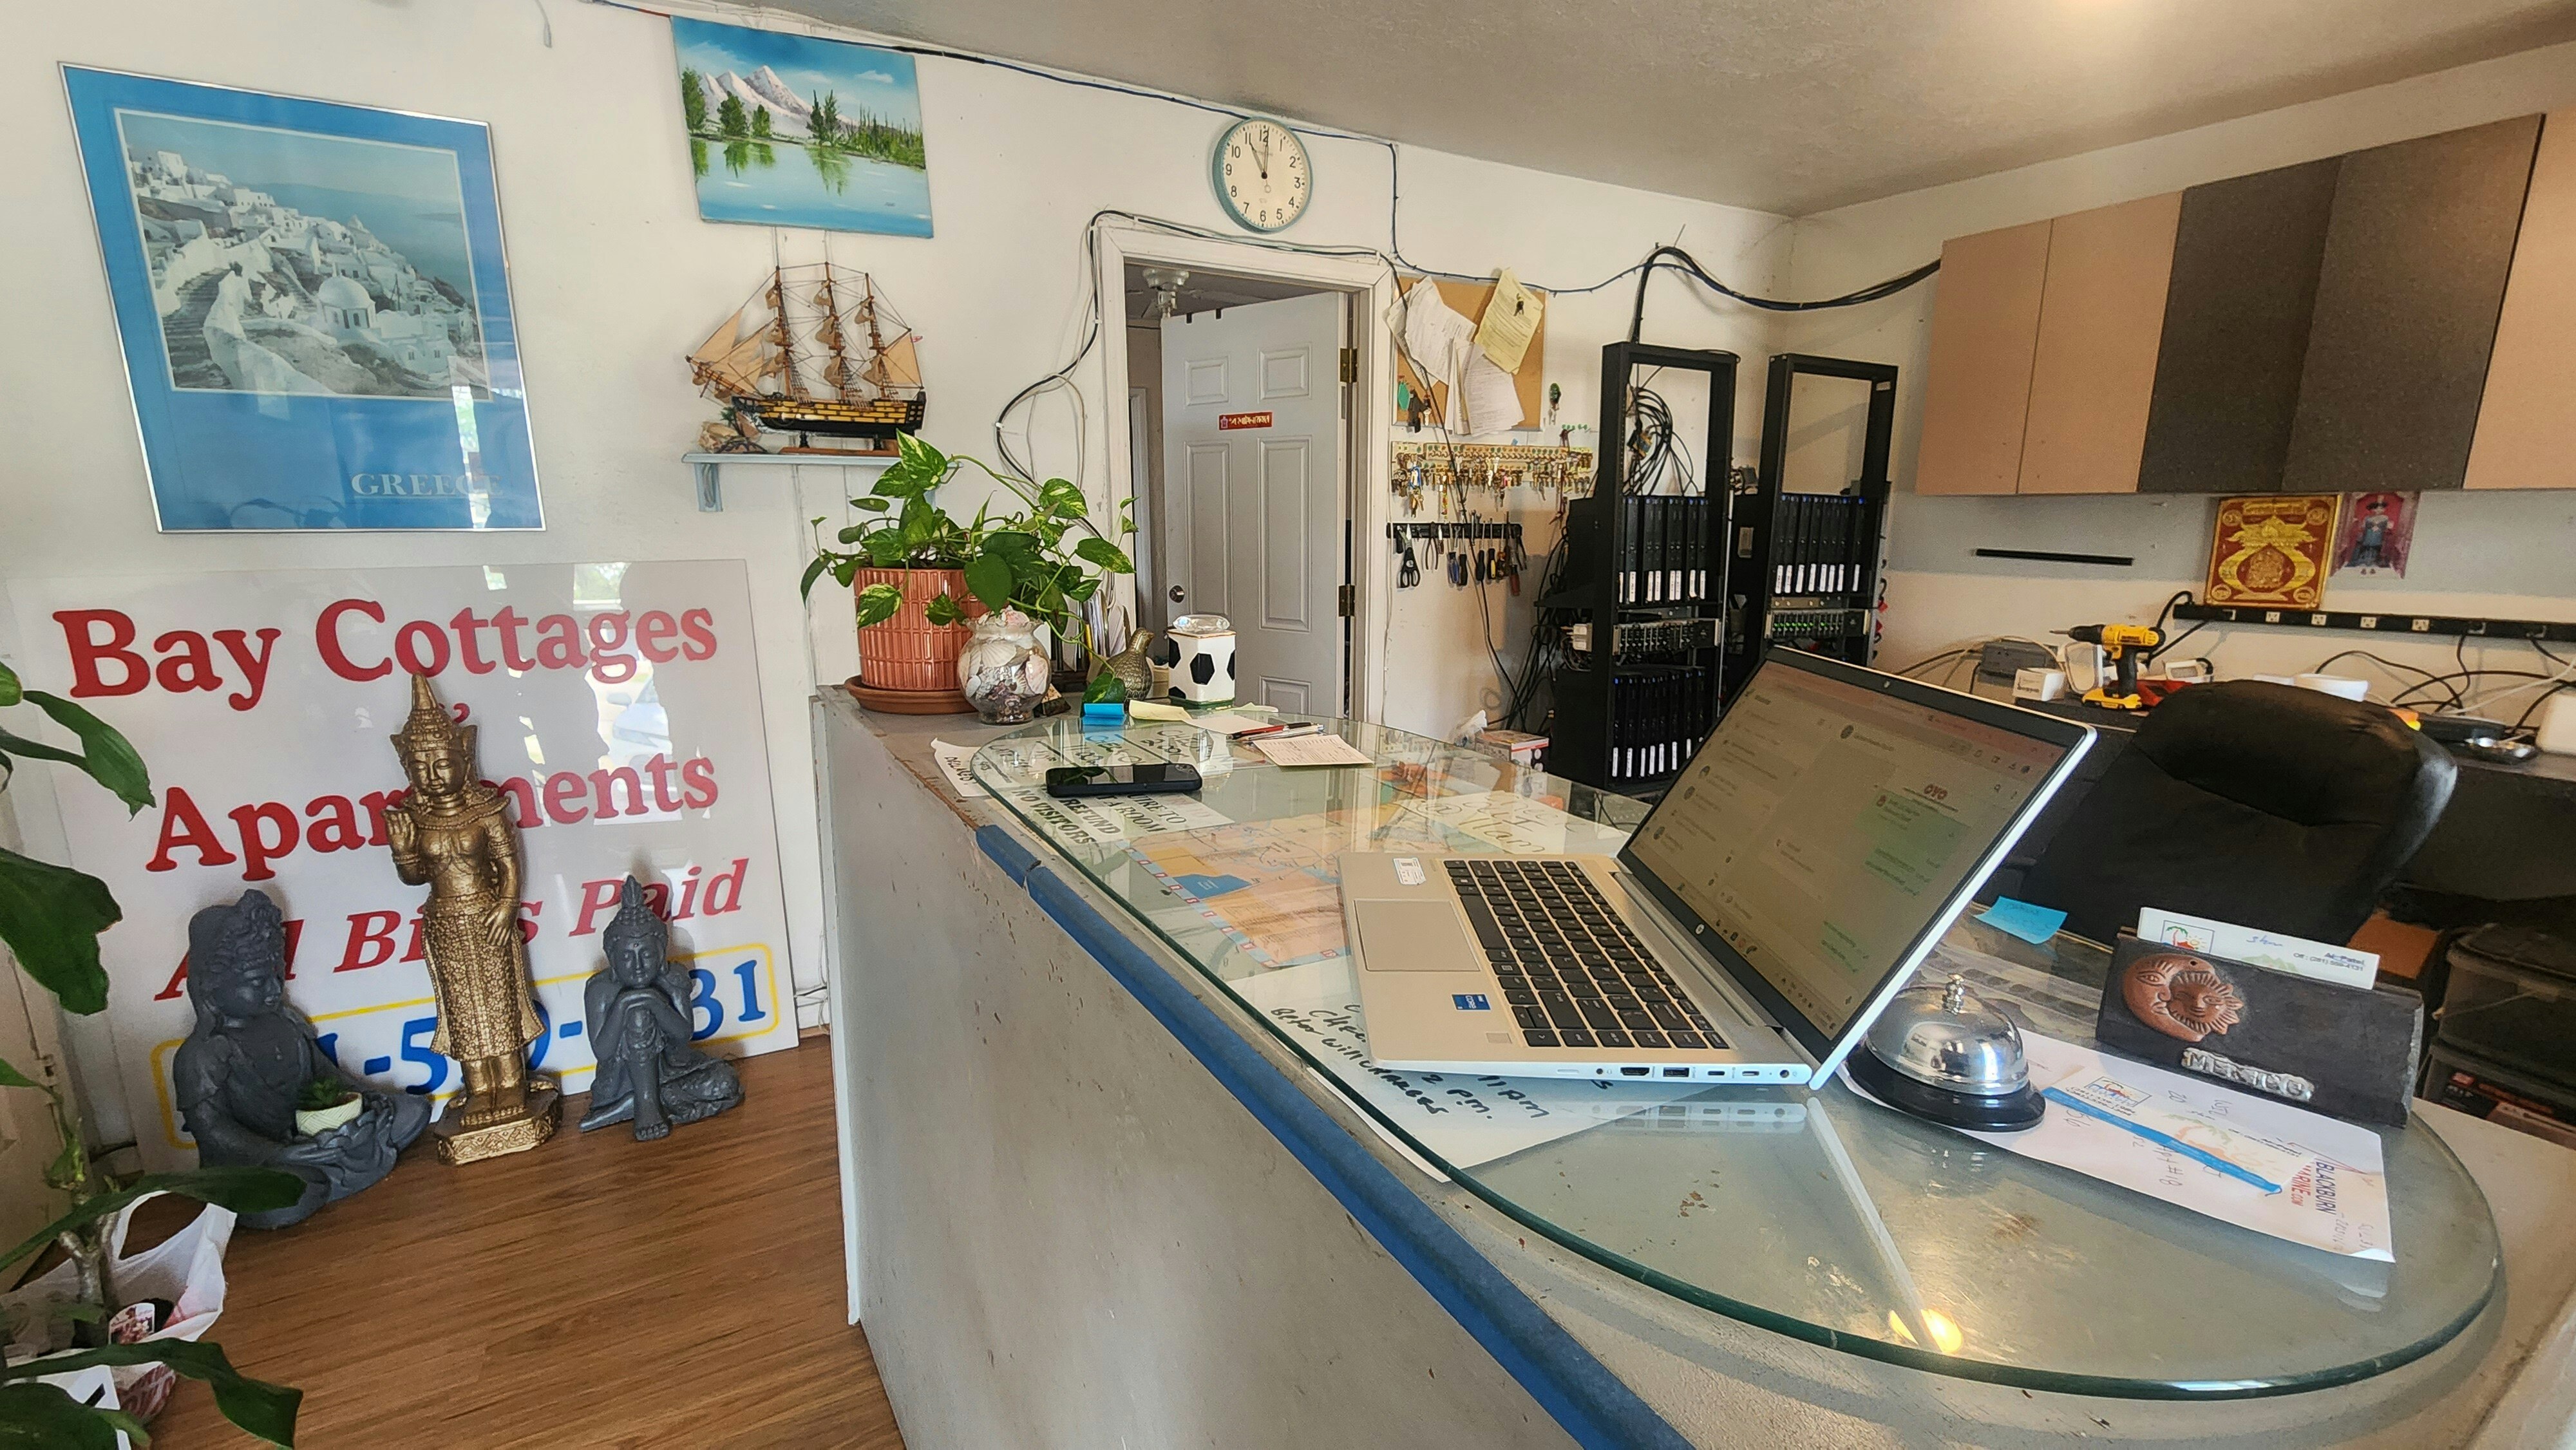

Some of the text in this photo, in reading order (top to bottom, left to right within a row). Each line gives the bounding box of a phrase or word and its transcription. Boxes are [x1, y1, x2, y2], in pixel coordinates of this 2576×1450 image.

[1245, 132, 1252, 144] 11
[1259, 129, 1269, 143] 12
[1279, 138, 1283, 152] 1
[1231, 145, 1241, 159] 10
[1289, 156, 1296, 169] 2
[1225, 163, 1233, 176] 9
[1294, 176, 1301, 189] 3
[1231, 185, 1238, 198] 8
[1243, 202, 1250, 214] 7
[1288, 196, 1295, 208] 4
[1260, 210, 1267, 222] 6
[1276, 208, 1283, 220] 5
[351, 473, 504, 496] GREECE
[52, 598, 718, 711] Bay Cottages
[1011, 789, 1098, 844] NO VISITORS
[1058, 798, 1121, 834] REFUND
[1115, 806, 1168, 833] ROOM
[1159, 811, 1187, 824] TO
[1421, 1073, 1444, 1085] 2
[2315, 1161, 2337, 1216] BLACKBURN
